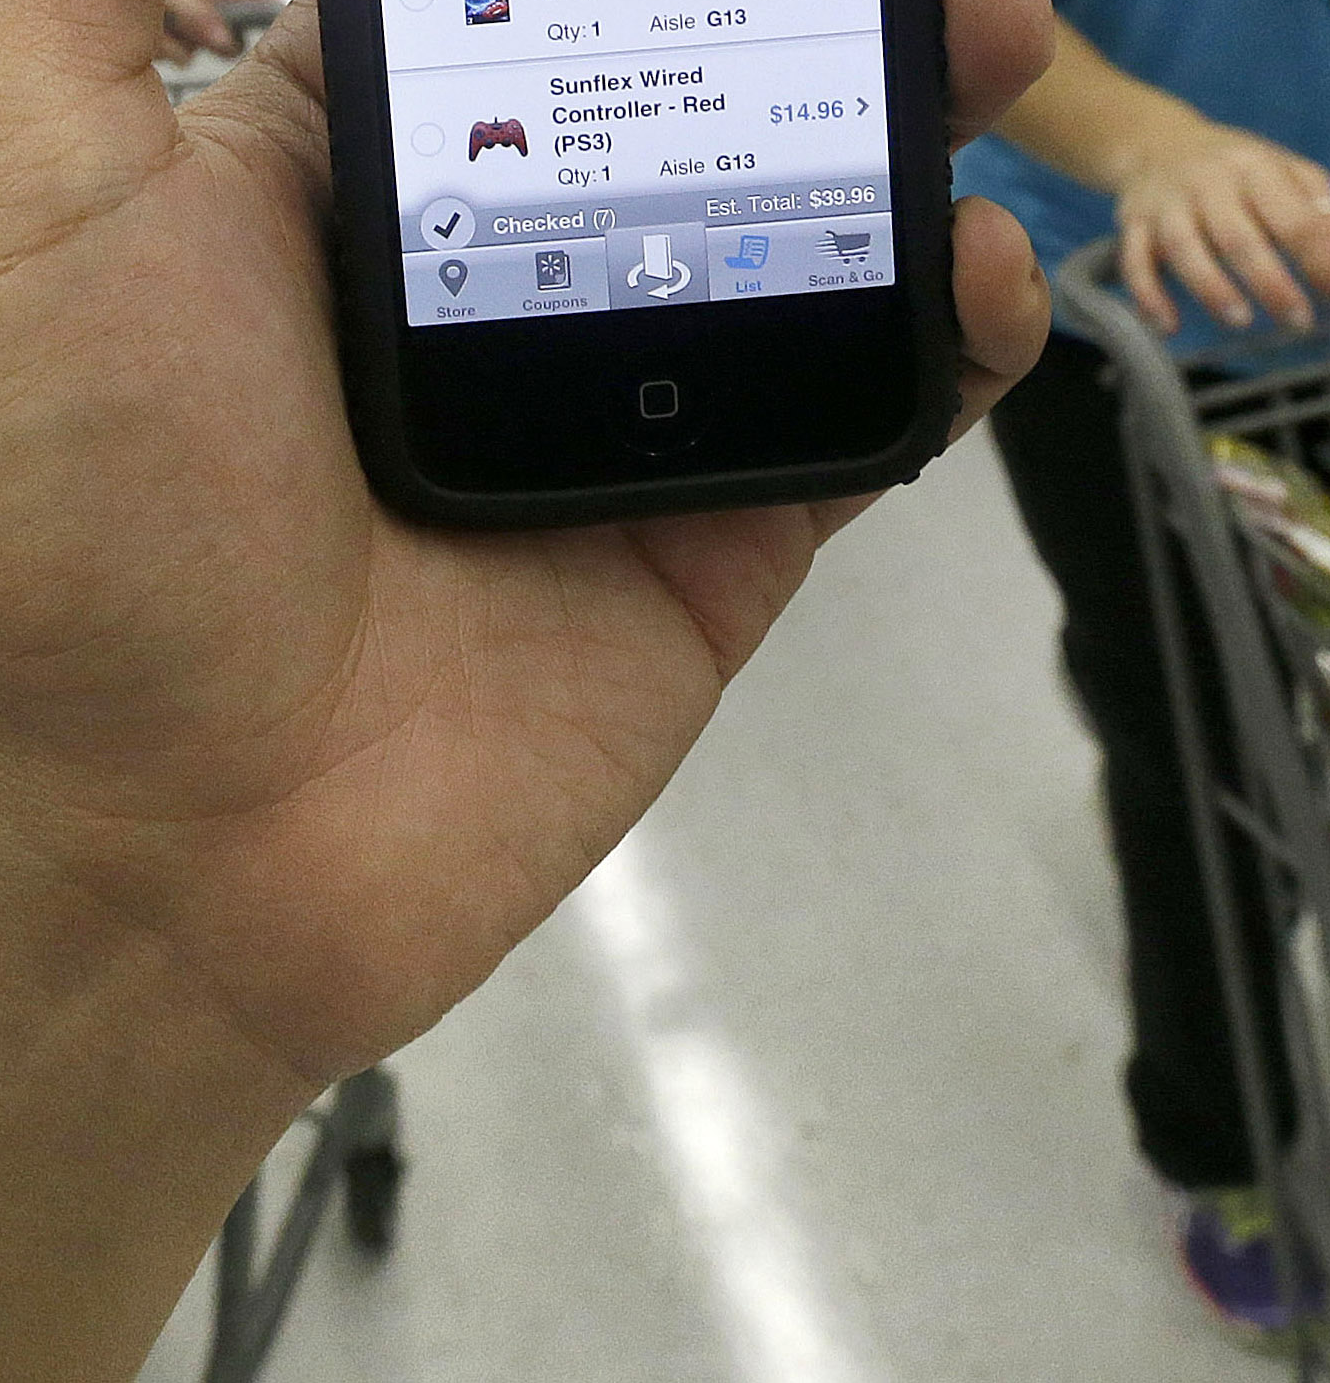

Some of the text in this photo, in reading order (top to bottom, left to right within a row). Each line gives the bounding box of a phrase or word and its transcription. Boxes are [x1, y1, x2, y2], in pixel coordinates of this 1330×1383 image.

[650, 9, 747, 32] Aisle G13
[547, 21, 601, 43] Qty: 1
[550, 66, 703, 95] Sunflex Wired
[552, 100, 661, 124] Controller
[683, 93, 726, 114] Red
[769, 100, 844, 125] $14.96
[554, 132, 613, 157] (PS3)
[659, 154, 756, 176] Aisle G13
[558, 166, 611, 187] Qty: 1
[706, 186, 876, 217] Est. Total: $39.96
[493, 208, 616, 234] Checked (7)
[736, 281, 762, 293] List
[808, 269, 884, 287] Scan & Go
[436, 306, 476, 318] Store
[522, 297, 588, 312] Coupons
